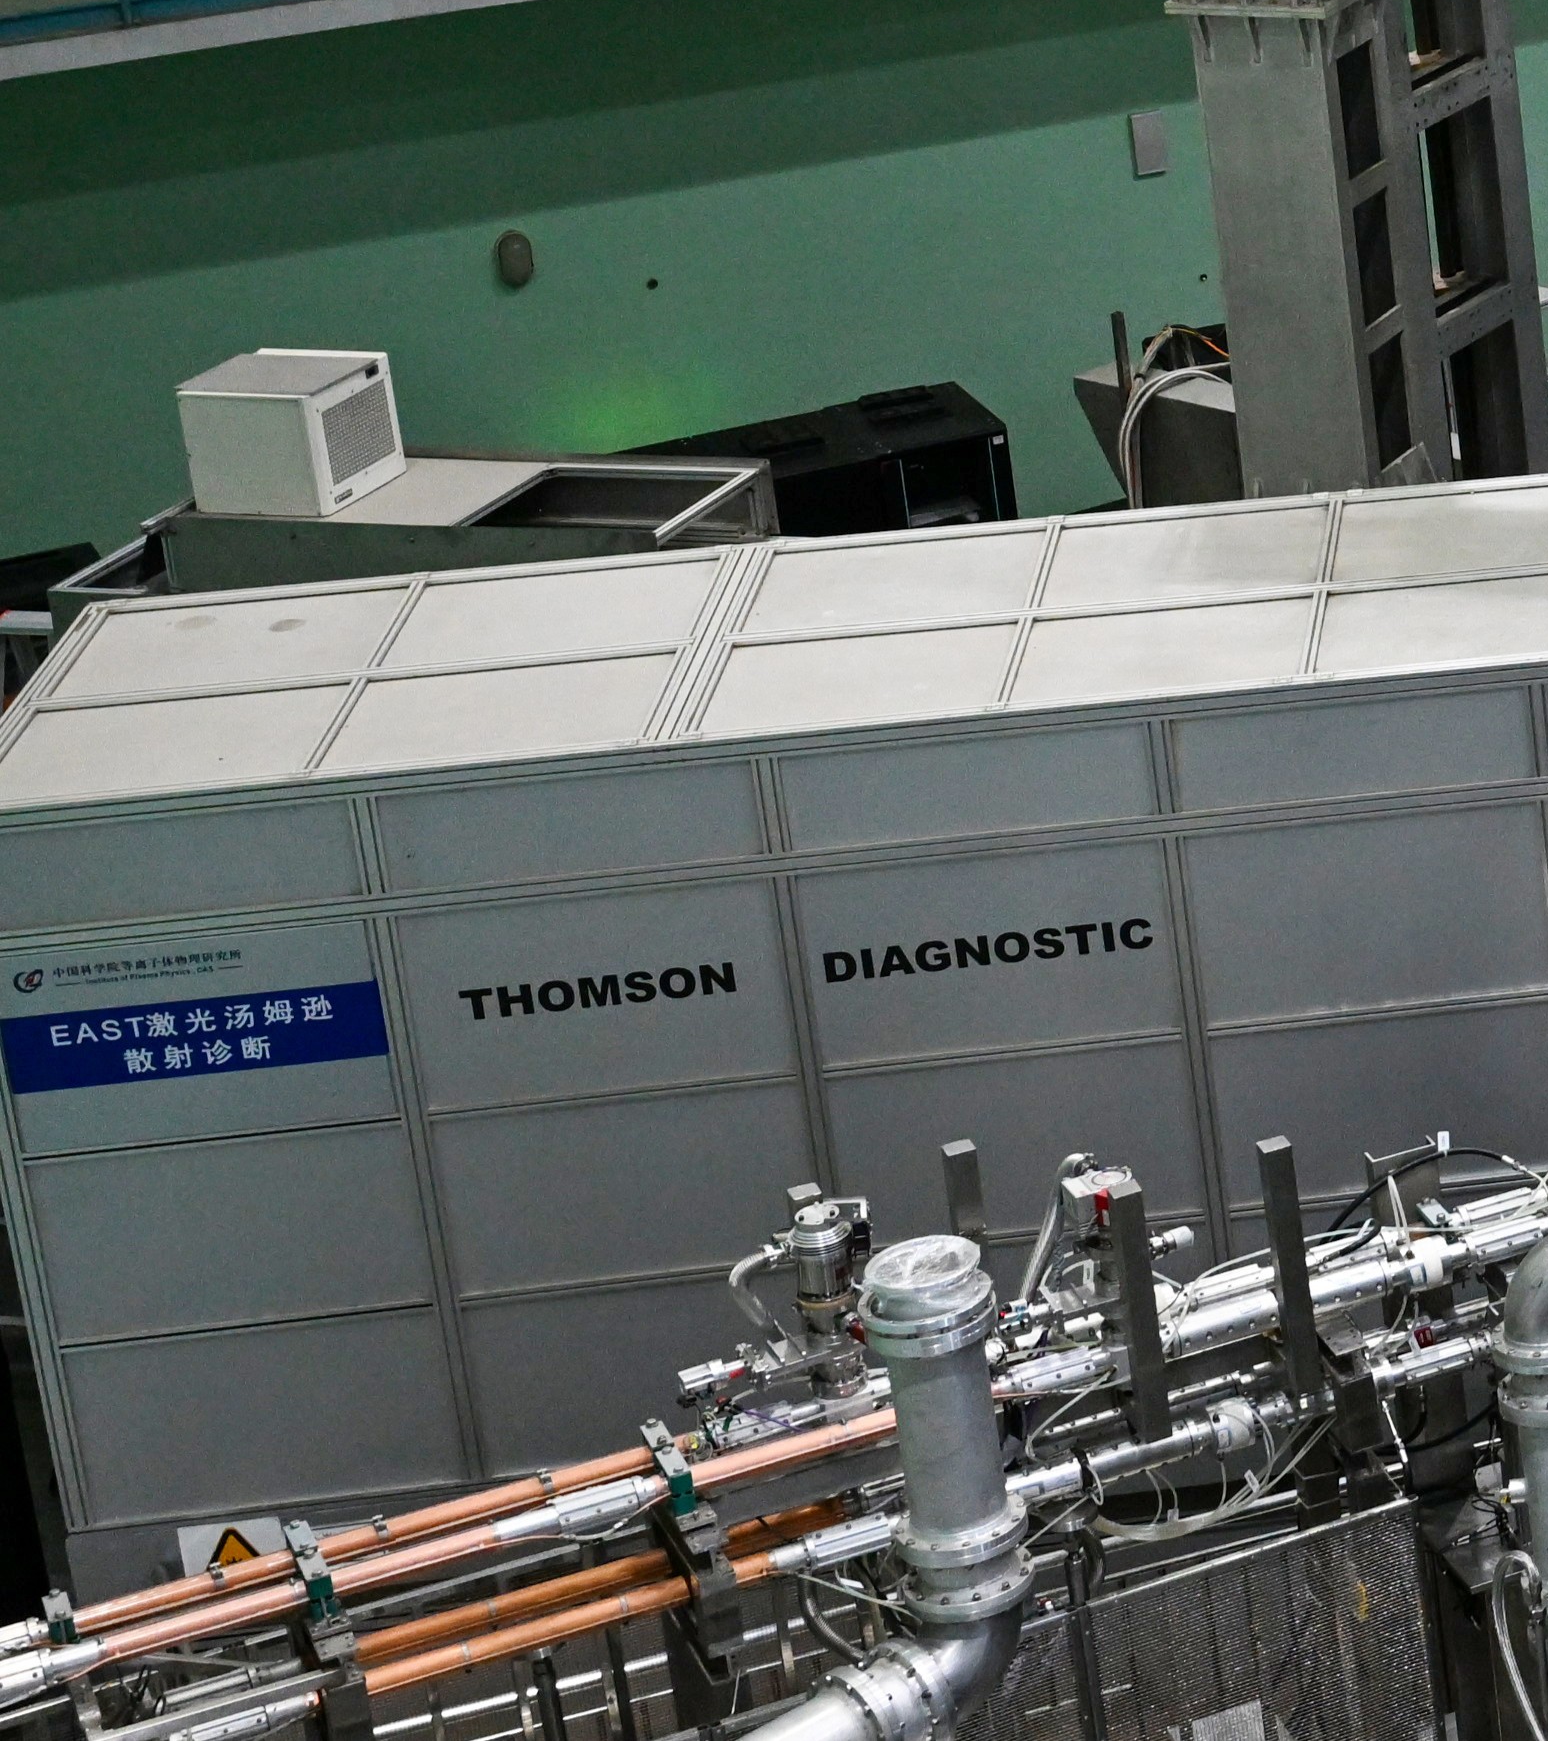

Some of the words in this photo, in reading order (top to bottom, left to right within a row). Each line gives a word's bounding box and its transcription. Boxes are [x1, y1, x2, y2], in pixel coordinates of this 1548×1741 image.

[459, 962, 738, 1020] THOMSON
[823, 918, 1154, 983] DIAGNOSTIC
[50, 994, 334, 1047] EAST激光汤姆逊
[124, 1035, 272, 1074] 散射诊断
